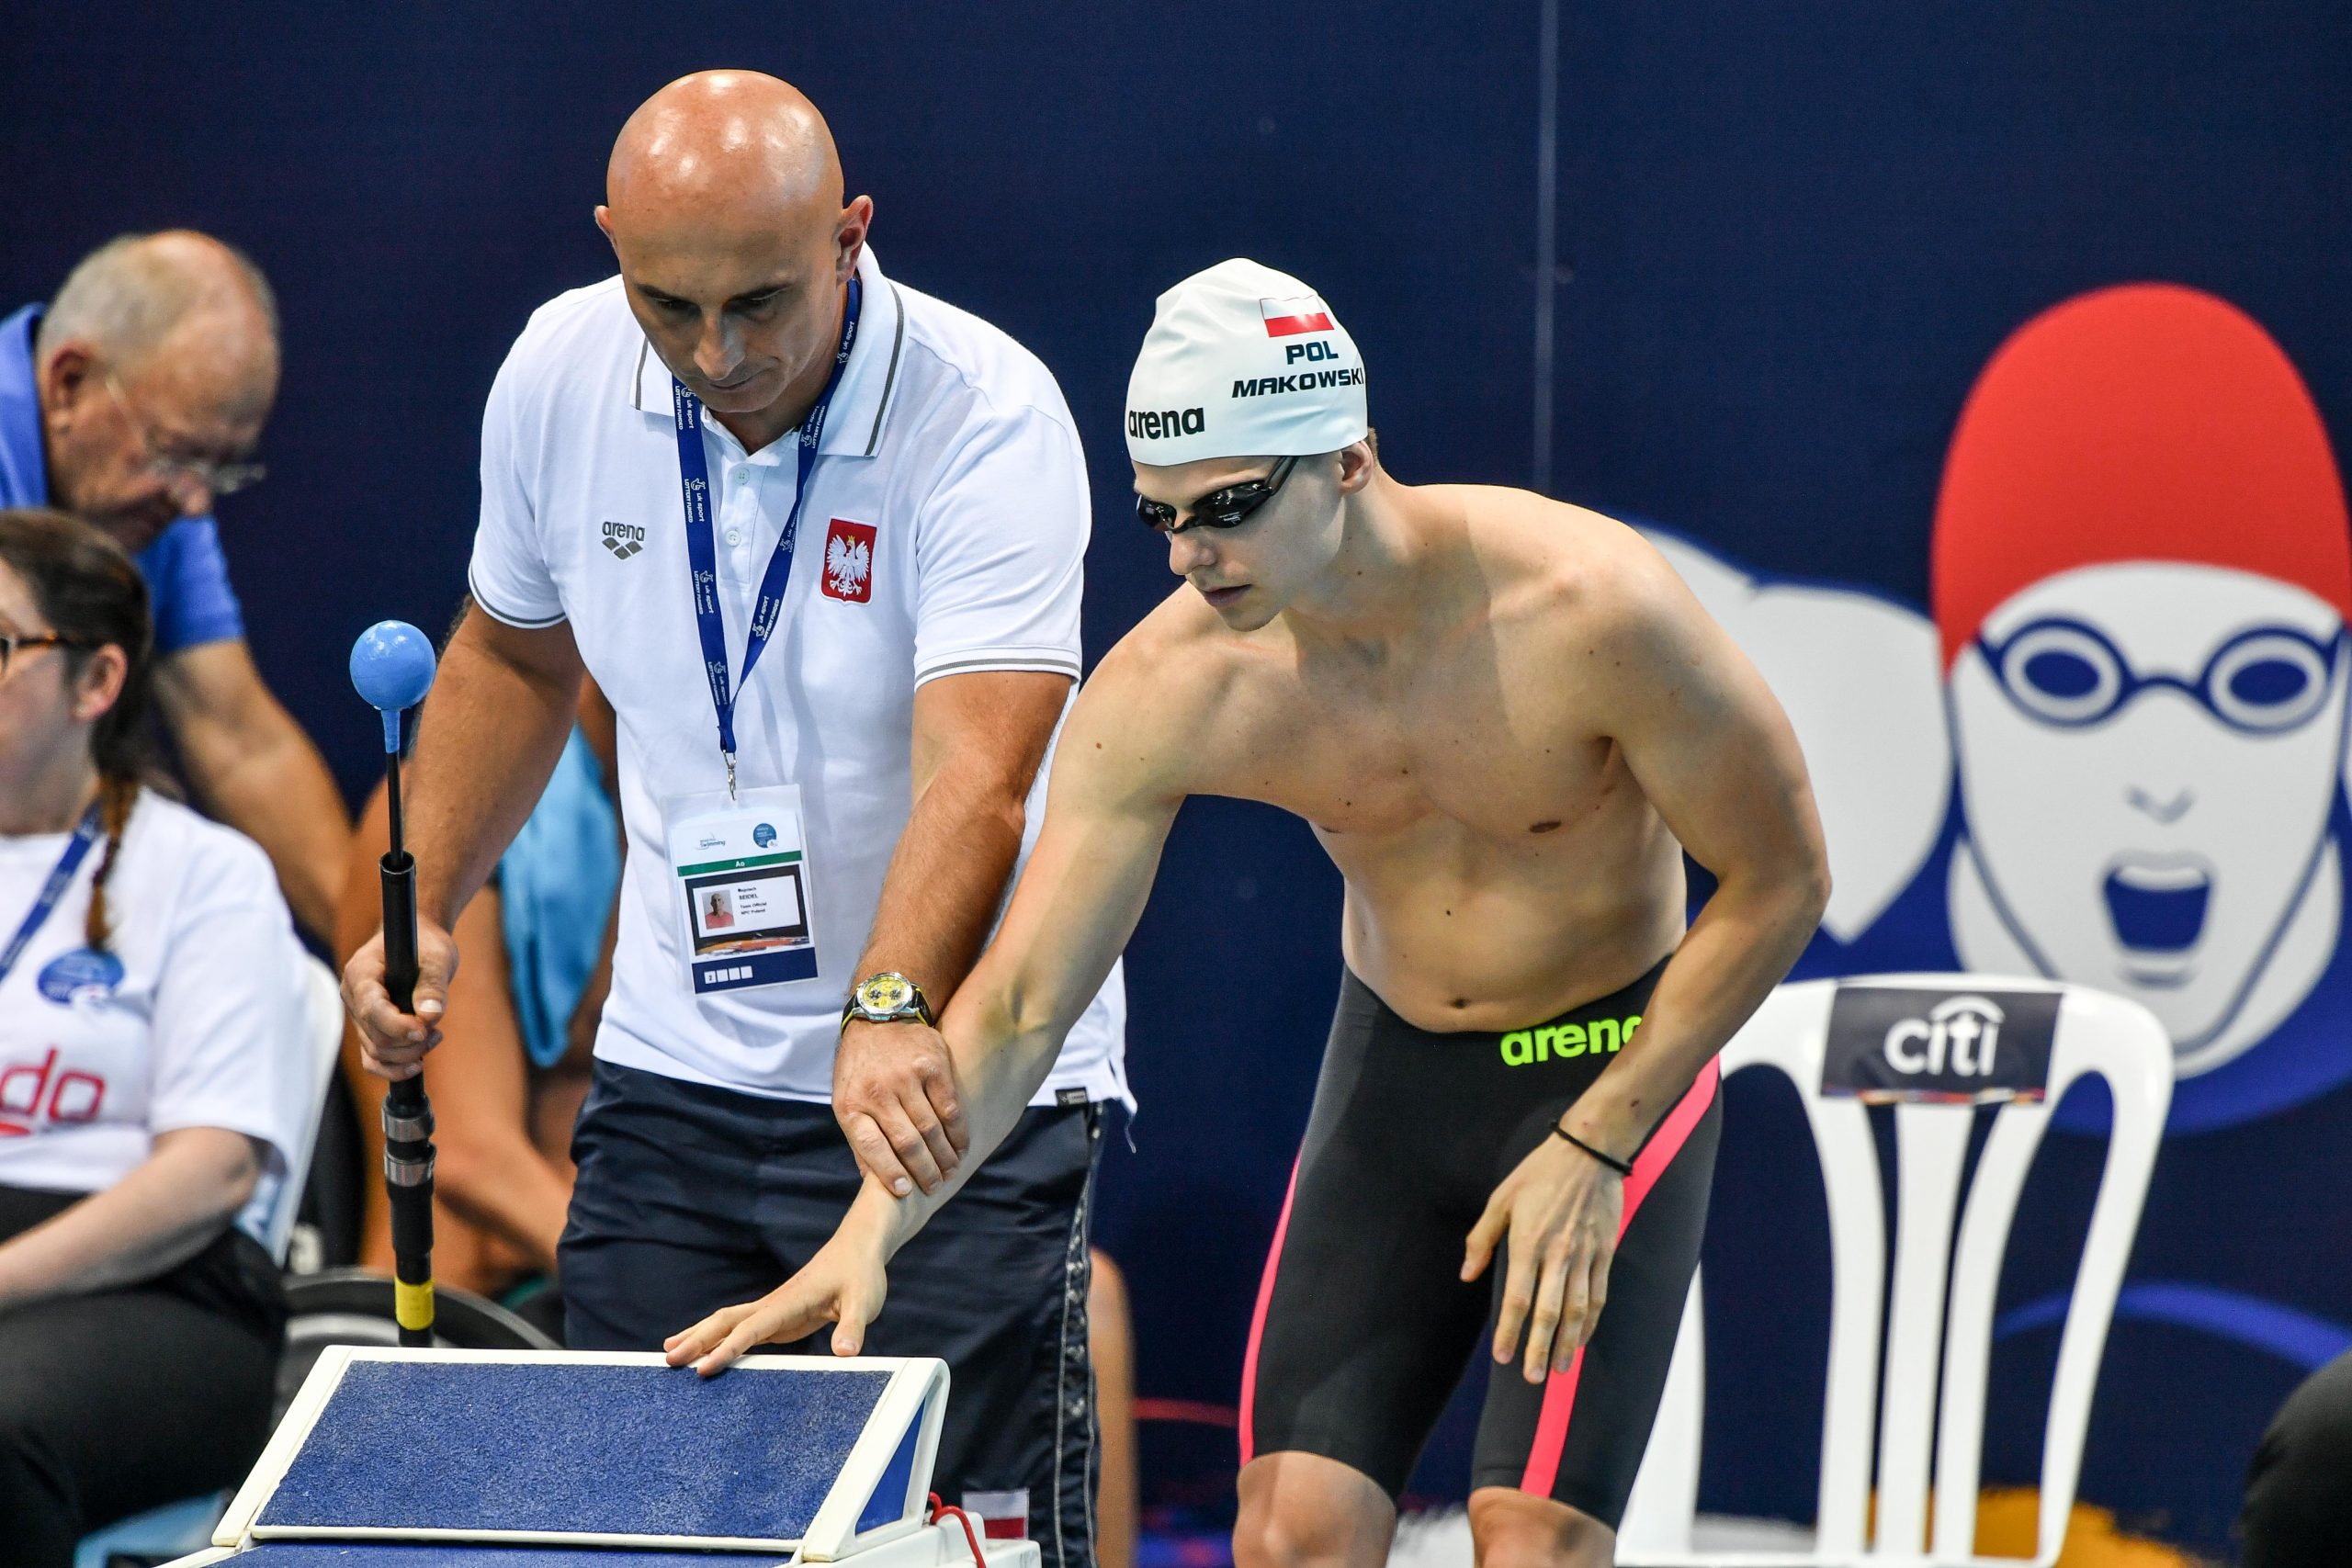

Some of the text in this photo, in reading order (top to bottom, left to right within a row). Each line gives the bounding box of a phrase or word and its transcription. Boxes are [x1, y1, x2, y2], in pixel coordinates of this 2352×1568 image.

[1285, 341, 1339, 366] POL
[1231, 367, 1364, 399] MAKOWSKI
[687, 400, 693, 409] uk
[1128, 407, 1205, 440] arena
[696, 492, 705, 522] uk sport
[602, 521, 646, 542] arena
[1883, 996, 2006, 1077] citi
